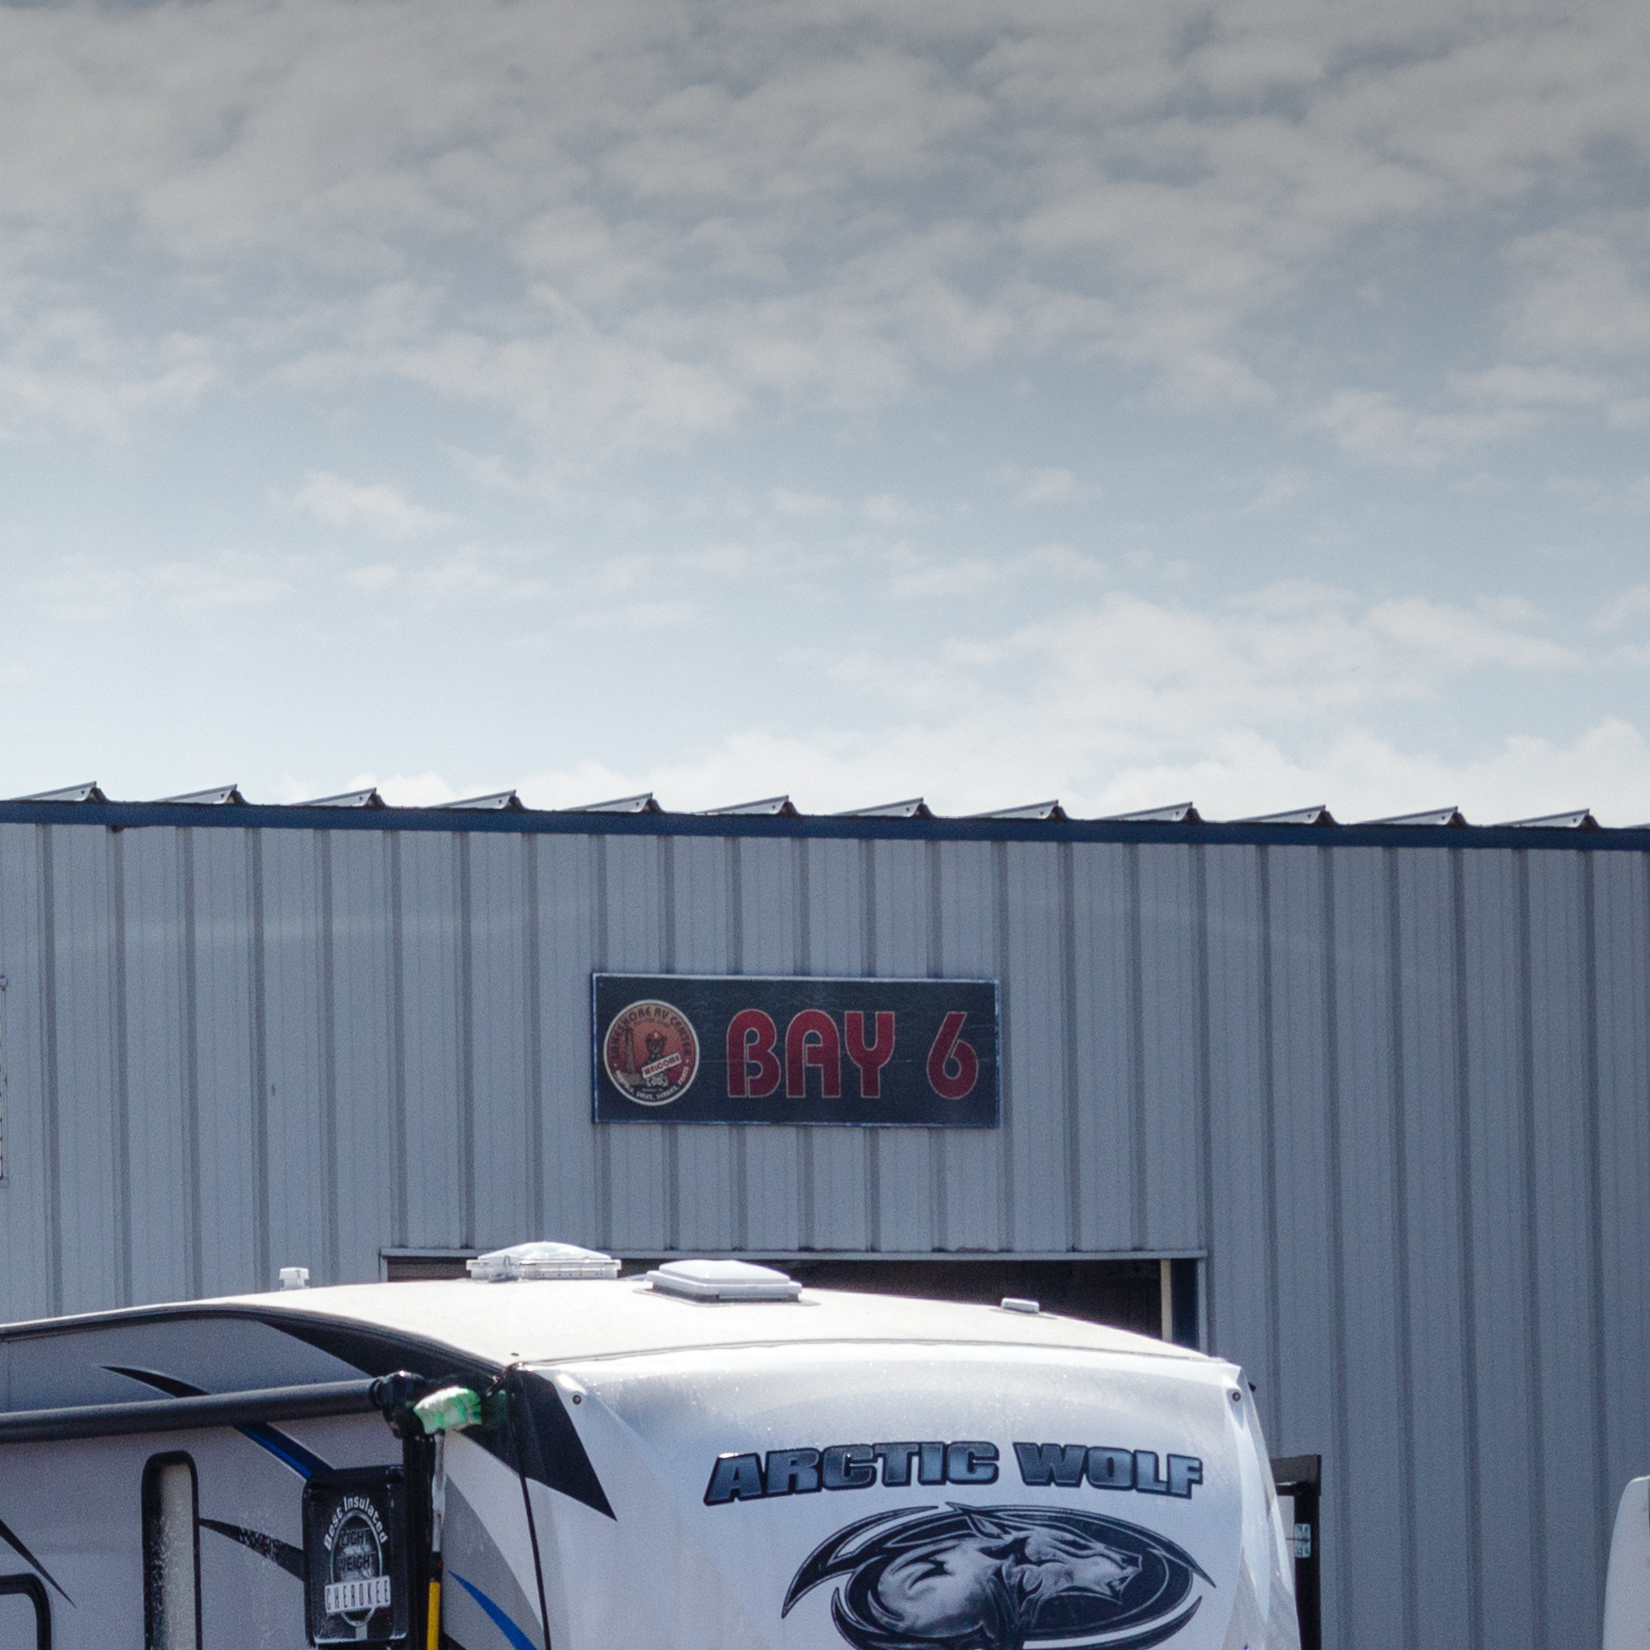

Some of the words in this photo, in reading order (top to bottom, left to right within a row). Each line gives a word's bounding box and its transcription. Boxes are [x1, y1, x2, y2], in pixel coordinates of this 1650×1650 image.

[611, 1007, 651, 1060] LAKESHORE
[654, 1007, 669, 1018] RV
[670, 1017, 692, 1056] CENTER
[726, 1008, 895, 1099] BAY
[926, 1011, 980, 1099] 6
[643, 1056, 680, 1075] WELCOME
[703, 1440, 1000, 1506] ARCTIC
[1013, 1441, 1204, 1499] WOLF
[323, 1505, 343, 1551] Best
[343, 1495, 389, 1545] Insulated
[339, 1527, 371, 1548] LIGHT
[326, 1579, 389, 1611] CHEROKEE
